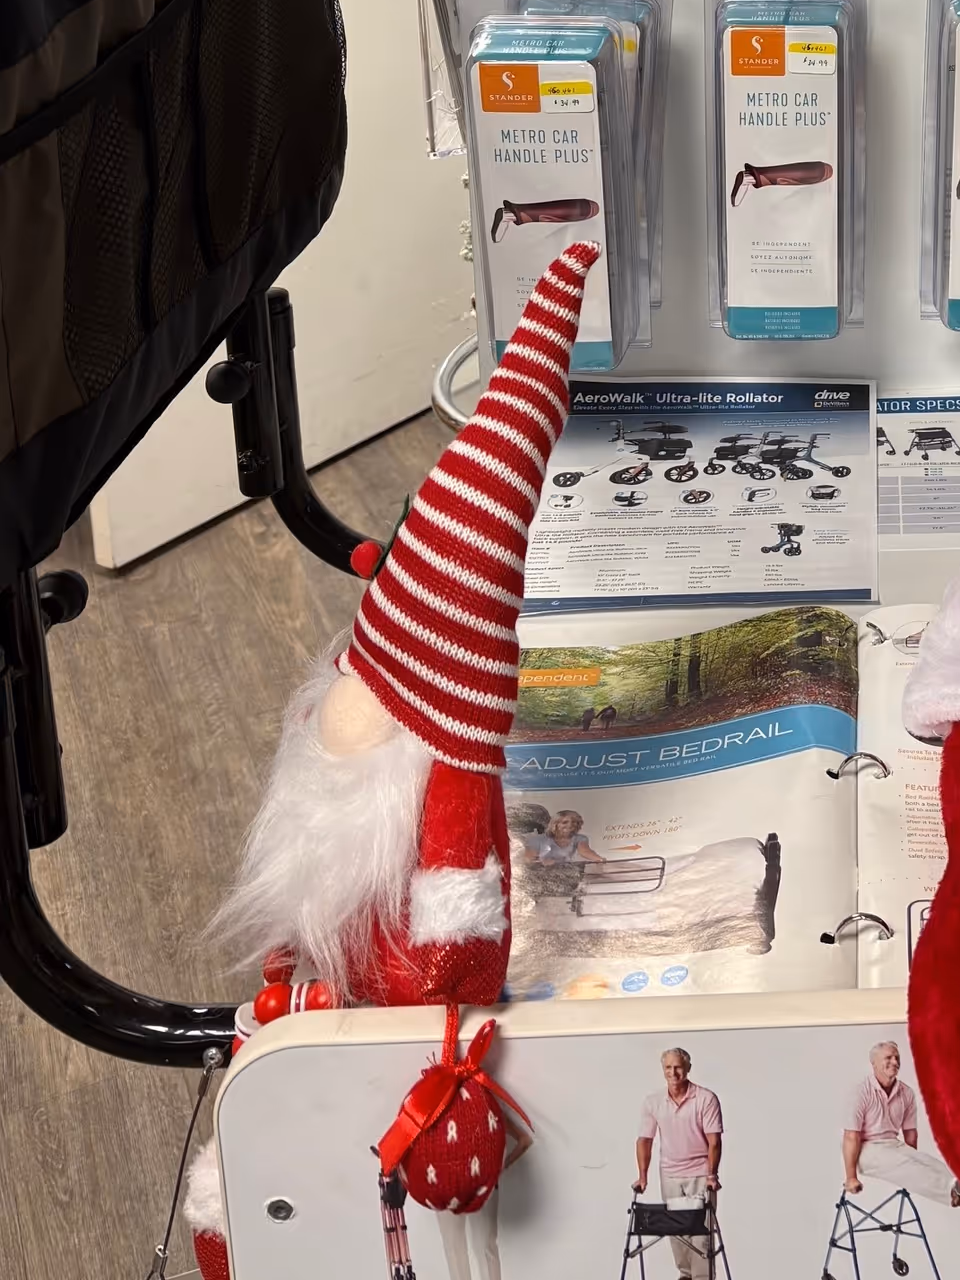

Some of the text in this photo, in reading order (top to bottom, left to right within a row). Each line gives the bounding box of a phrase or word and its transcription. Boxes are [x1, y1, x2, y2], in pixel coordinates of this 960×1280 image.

[747, 93, 818, 107] METRO CAR
[739, 112, 788, 126] HANDLE
[501, 130, 578, 144] METRO CAR
[494, 148, 547, 163] HANDLE
[656, 393, 722, 404] Ultra-lite
[726, 392, 784, 403] Rollator
[814, 390, 851, 400] drive
[520, 721, 794, 771] ADJUST BEDRAIL
[639, 761, 681, 773] VERSATILE
[683, 758, 699, 766] BED
[699, 754, 717, 764] RAIL
[602, 832, 631, 841] PIVOTS
[632, 829, 661, 838] DOWN
